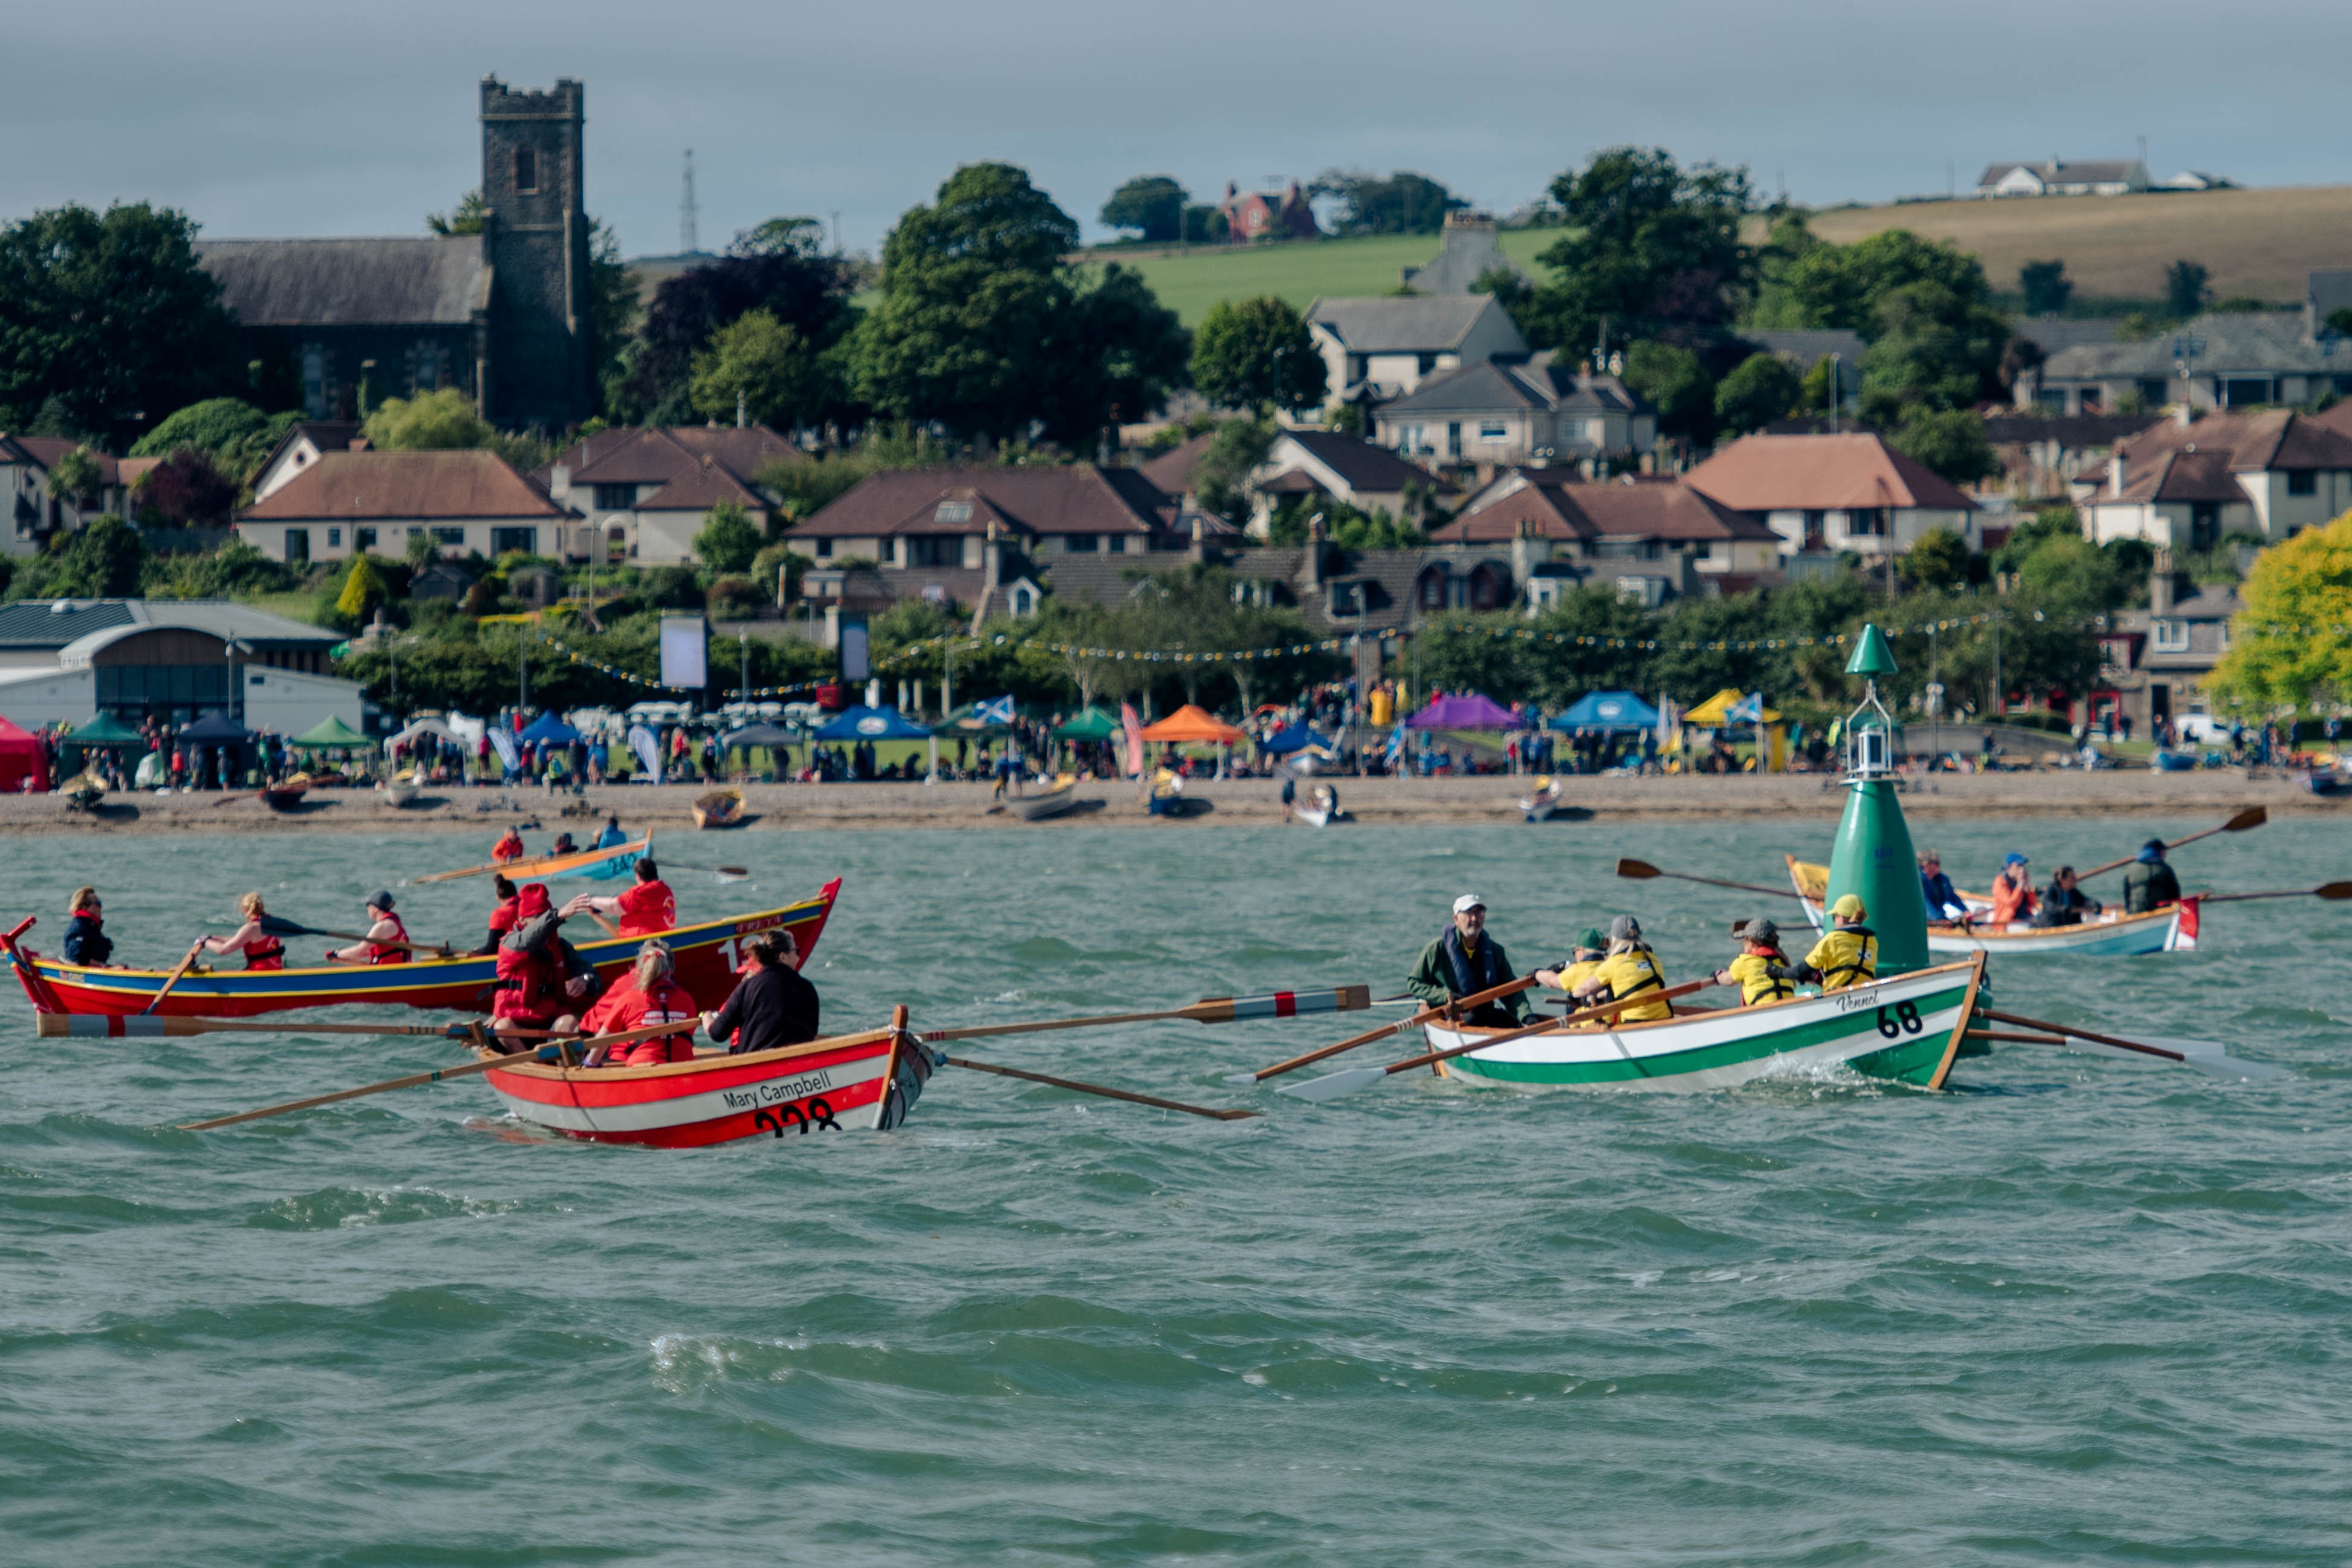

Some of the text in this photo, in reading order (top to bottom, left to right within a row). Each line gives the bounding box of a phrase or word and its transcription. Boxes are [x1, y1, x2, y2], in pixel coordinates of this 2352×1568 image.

[1836, 989, 1879, 1012] Vennel
[1877, 1001, 1922, 1039] 68
[723, 1070, 831, 1108] Mary Campbell
